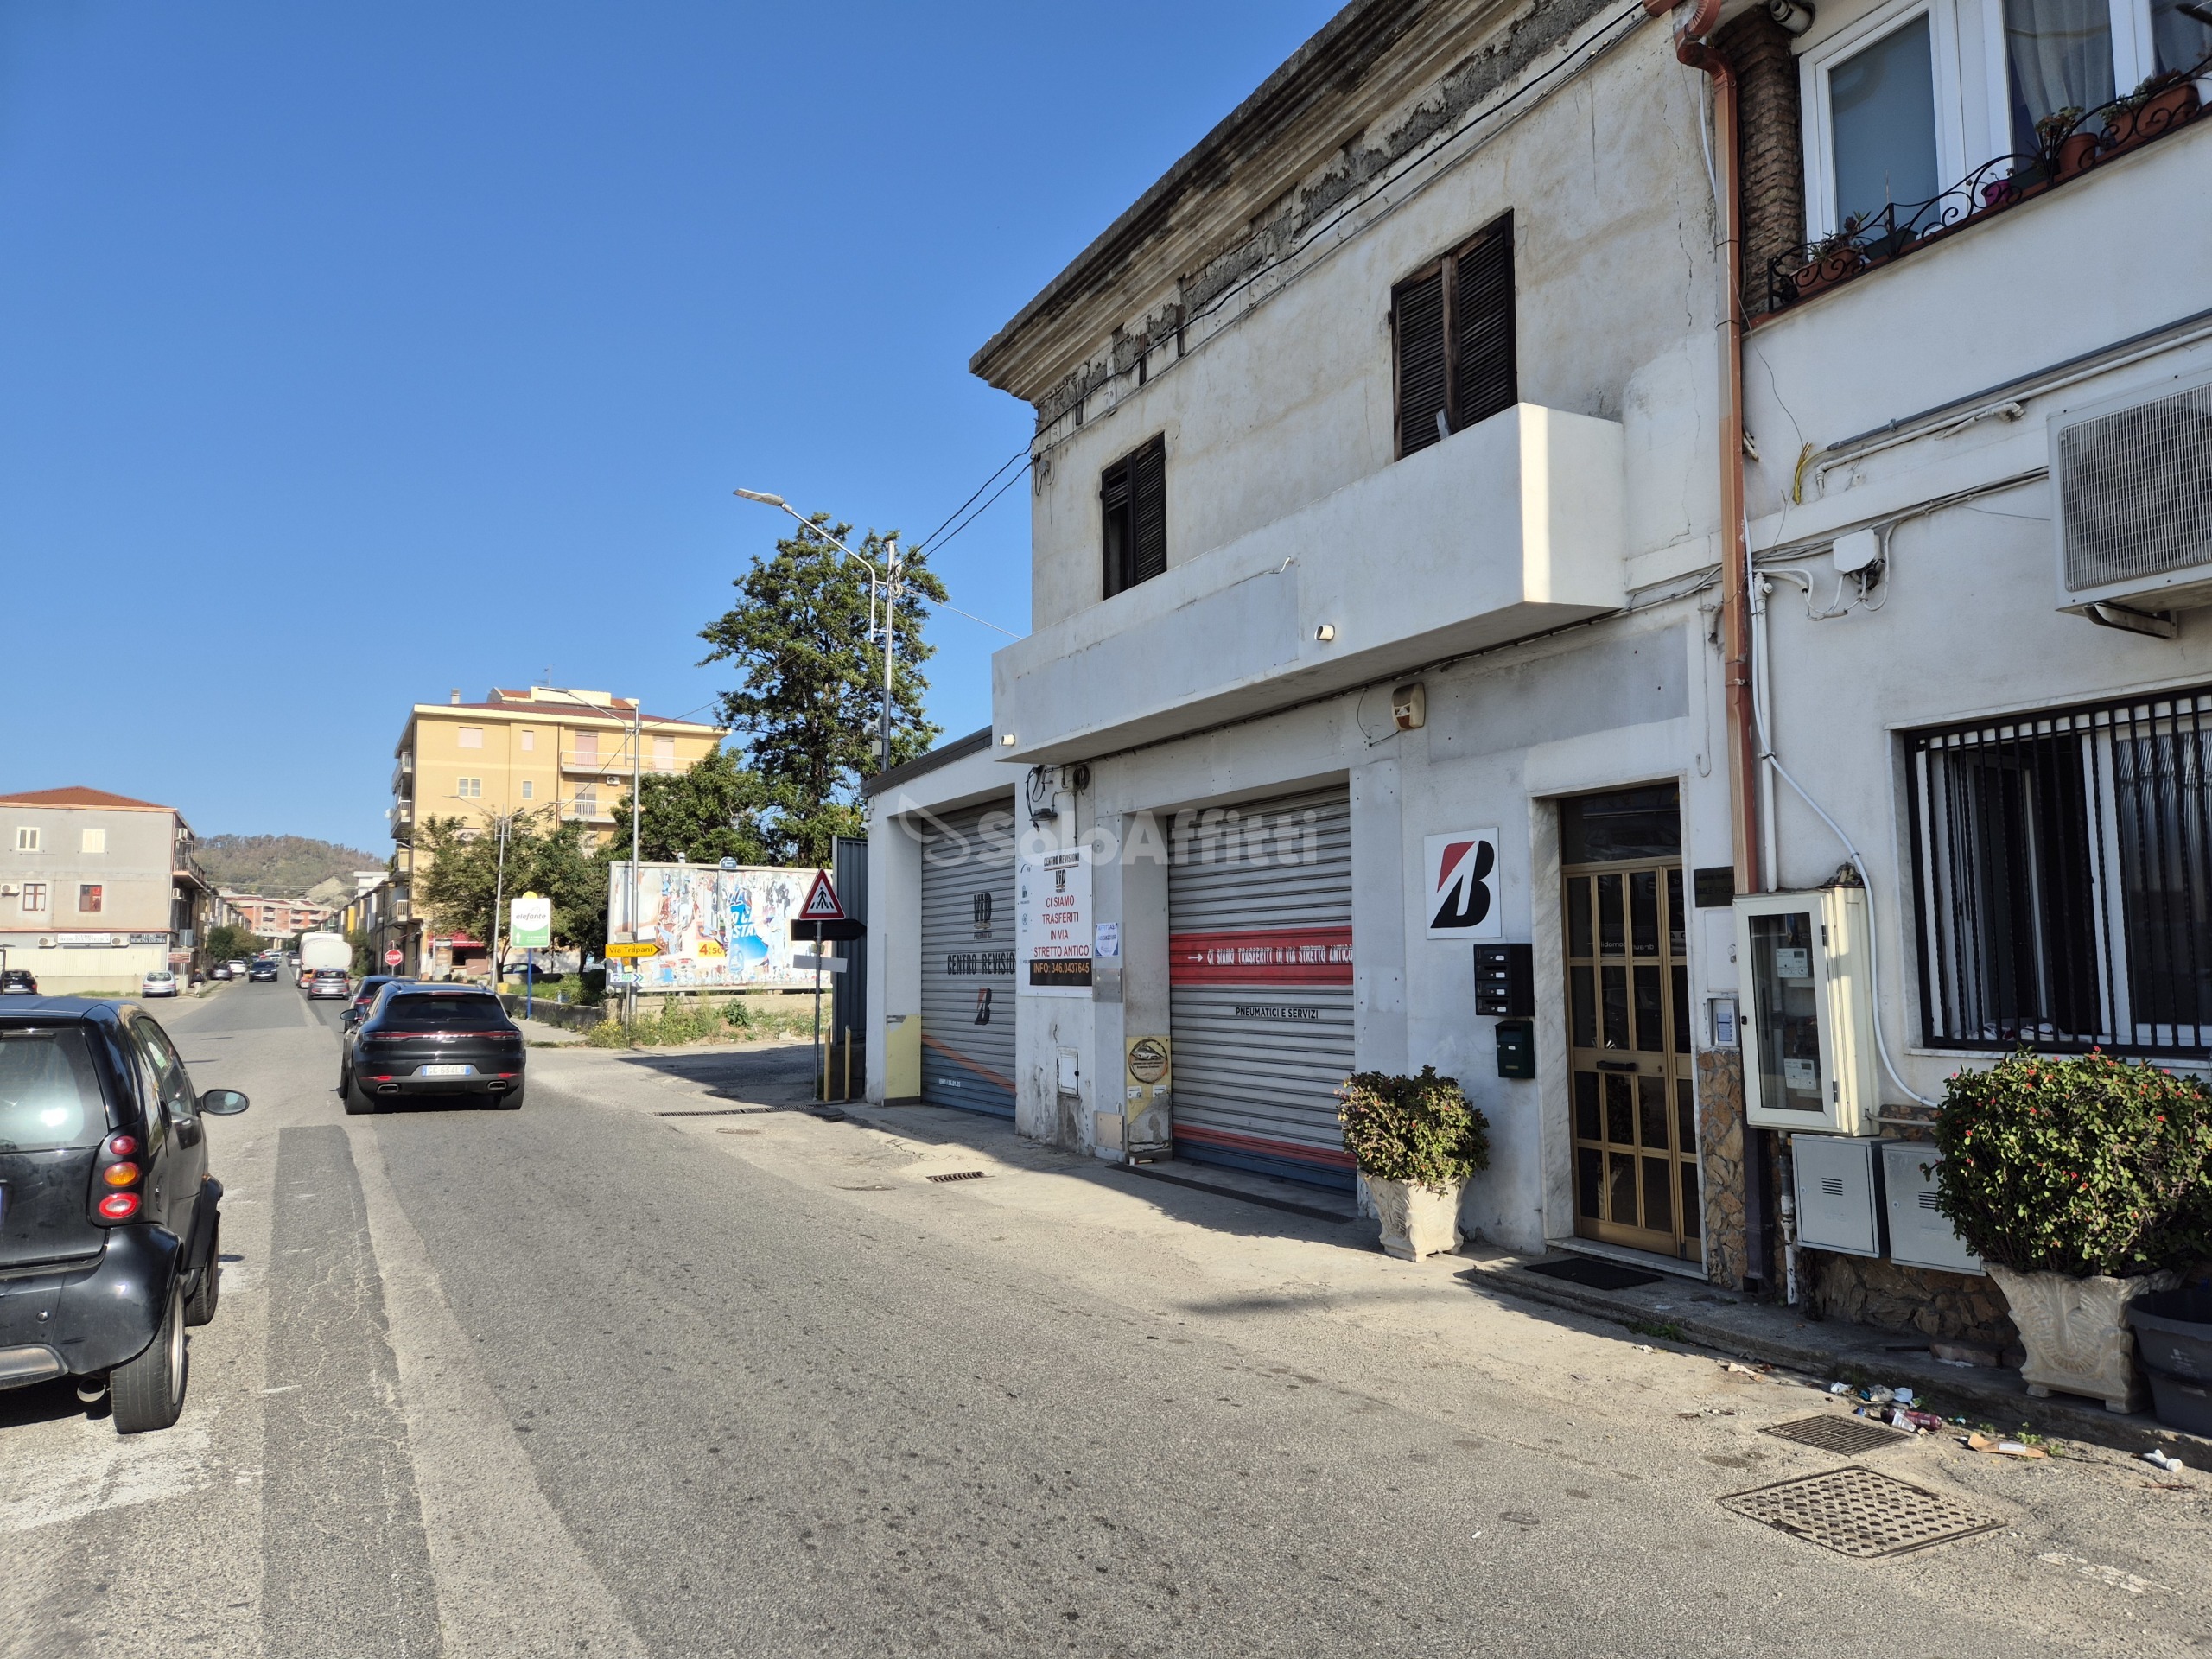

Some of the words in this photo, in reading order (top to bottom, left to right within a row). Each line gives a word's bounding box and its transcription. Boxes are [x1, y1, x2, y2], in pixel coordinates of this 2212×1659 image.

[1044, 855, 1058, 867] CENTRO
[1059, 853, 1079, 866] REVISIONI
[1046, 897, 1053, 908] CI
[1053, 895, 1075, 907] SIAMO
[1042, 912, 1079, 924] TRASFERITI
[1050, 930, 1056, 941] IN
[1058, 929, 1069, 940] VIA
[624, 946, 652, 955] Trapani
[1033, 946, 1063, 957] STRETTO
[1064, 944, 1090, 957] ANTICO
[1207, 949, 1214, 965] CI
[1217, 948, 1235, 965] SIAMO
[1238, 947, 1273, 965] TRASFERITI
[1276, 947, 1283, 964] IN
[1285, 946, 1296, 964] VIA
[1299, 945, 1326, 963] STRETTO
[1329, 944, 1353, 963] ANTICO
[947, 953, 977, 976] CENTRO
[1033, 963, 1051, 974] INFO:
[1052, 963, 1090, 974] 346.0437645
[1236, 1007, 1279, 1018] PNEUMATICI
[1281, 1007, 1286, 1018] E
[1288, 1008, 1319, 1019] SERVIZI
